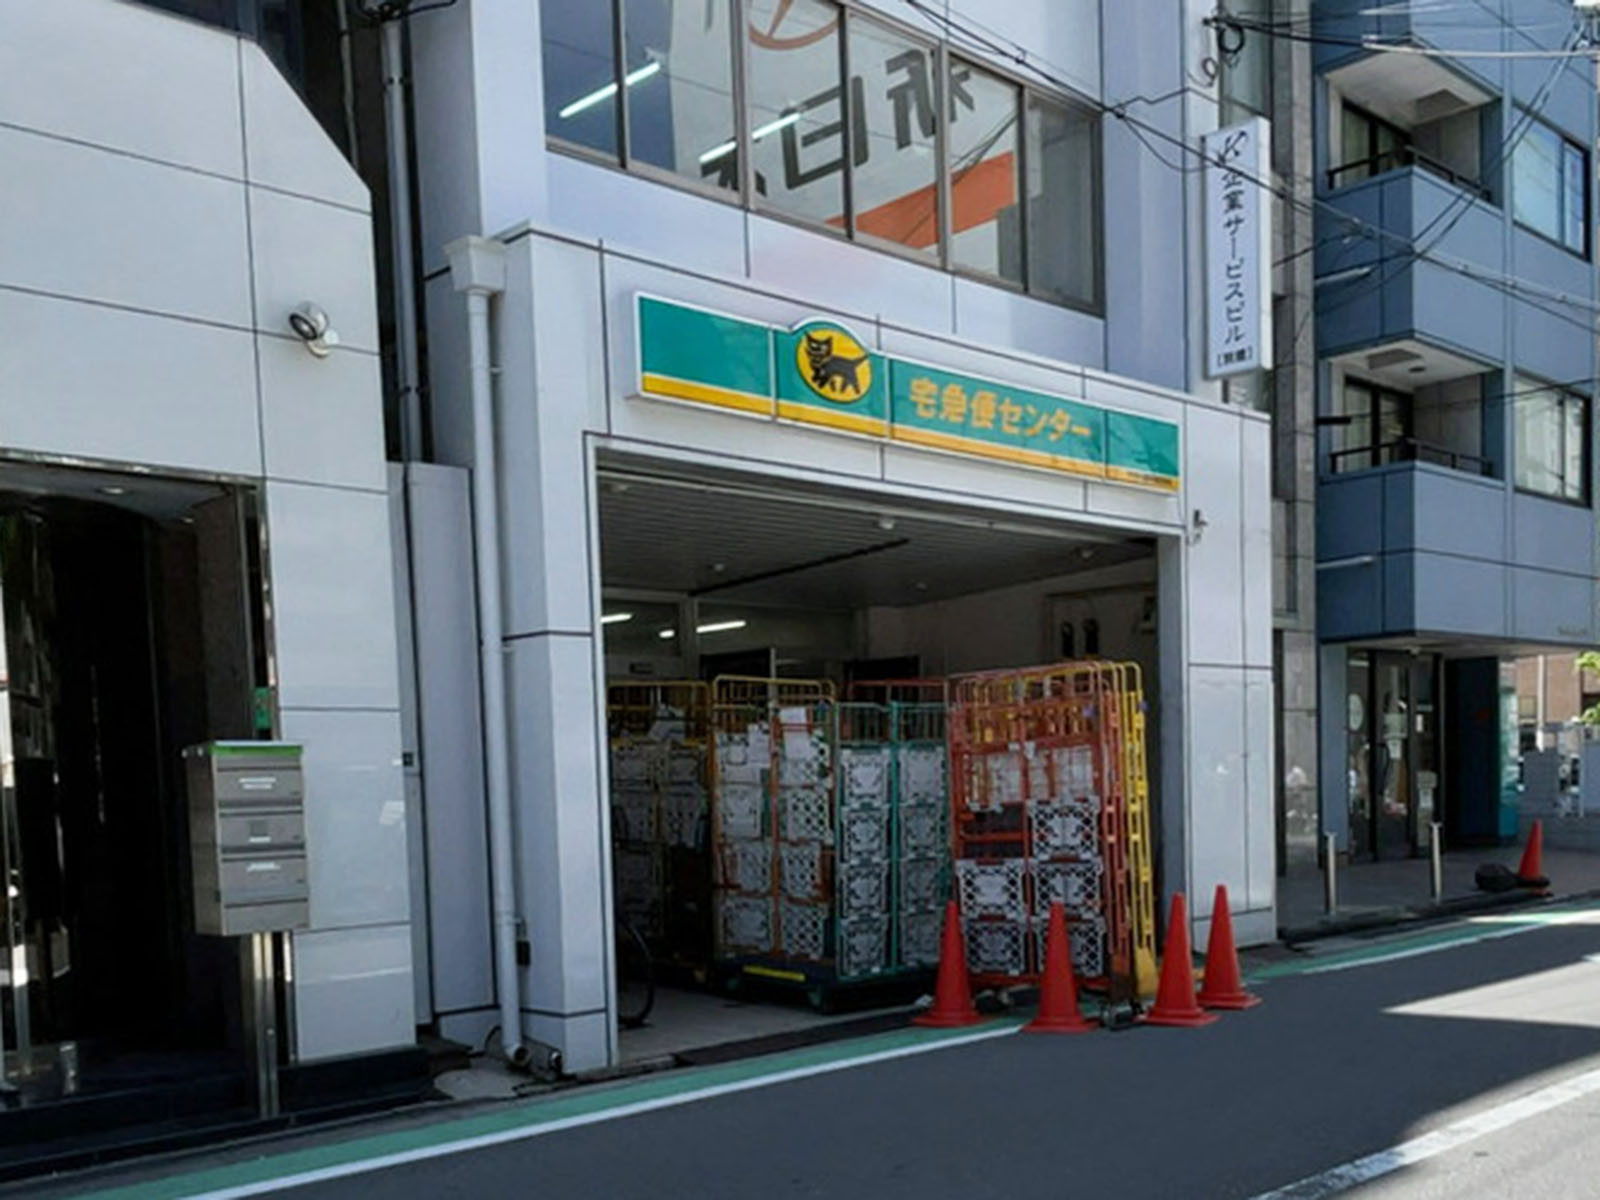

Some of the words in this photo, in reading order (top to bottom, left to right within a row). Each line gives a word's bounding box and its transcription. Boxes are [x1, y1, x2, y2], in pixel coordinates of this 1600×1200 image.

[909, 376, 1091, 442] 宅急便センター
